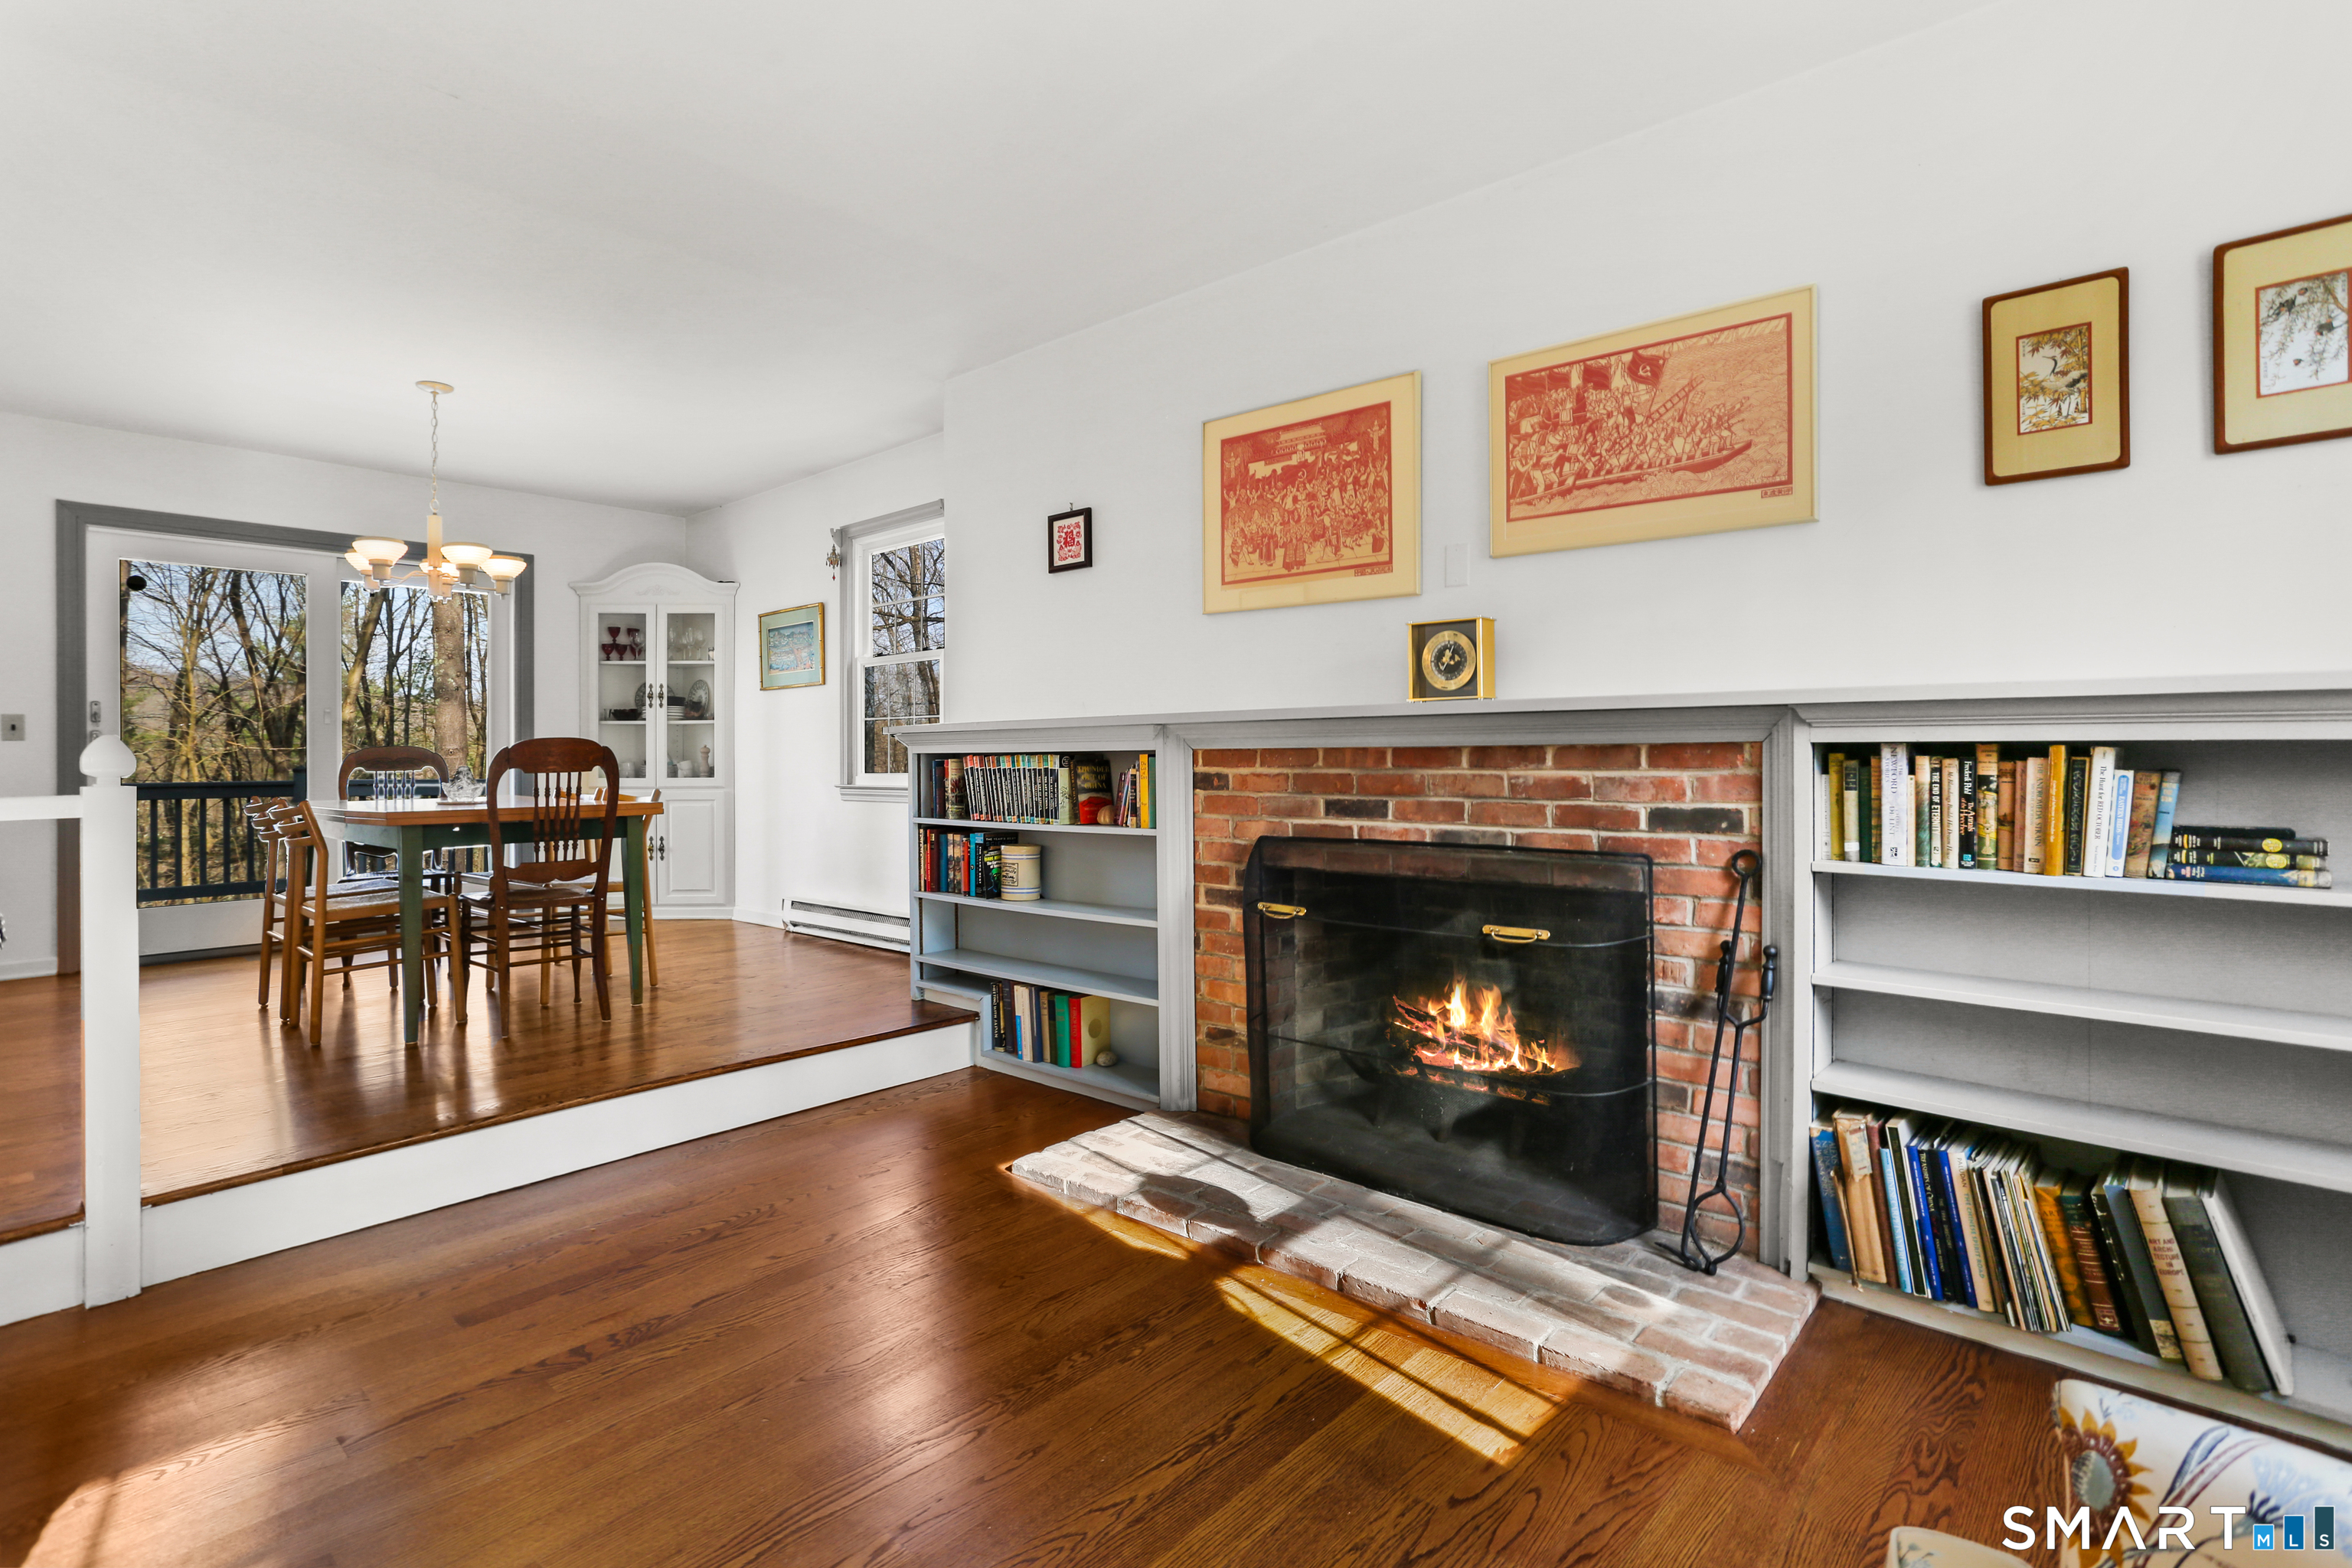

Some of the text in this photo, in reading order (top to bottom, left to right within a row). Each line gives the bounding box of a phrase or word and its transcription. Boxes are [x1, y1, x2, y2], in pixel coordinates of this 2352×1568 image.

[1063, 530, 1076, 548] 福
[1963, 761, 1972, 795] Frederik Pohl
[1932, 796, 1939, 805] OF
[1931, 805, 1940, 834] ETERNITY
[2094, 813, 2103, 840] OCTOBER
[1886, 1168, 1894, 1198] CHINESE
[1919, 1152, 1929, 1183] TREASURES
[1926, 1191, 1936, 1212] CHINA
[1957, 1158, 1968, 1187] PALUDAN
[1965, 1206, 1977, 1234] CHINESE
[1971, 1235, 1981, 1257] SPIRIT
[1975, 1258, 1985, 1279] ROAD
